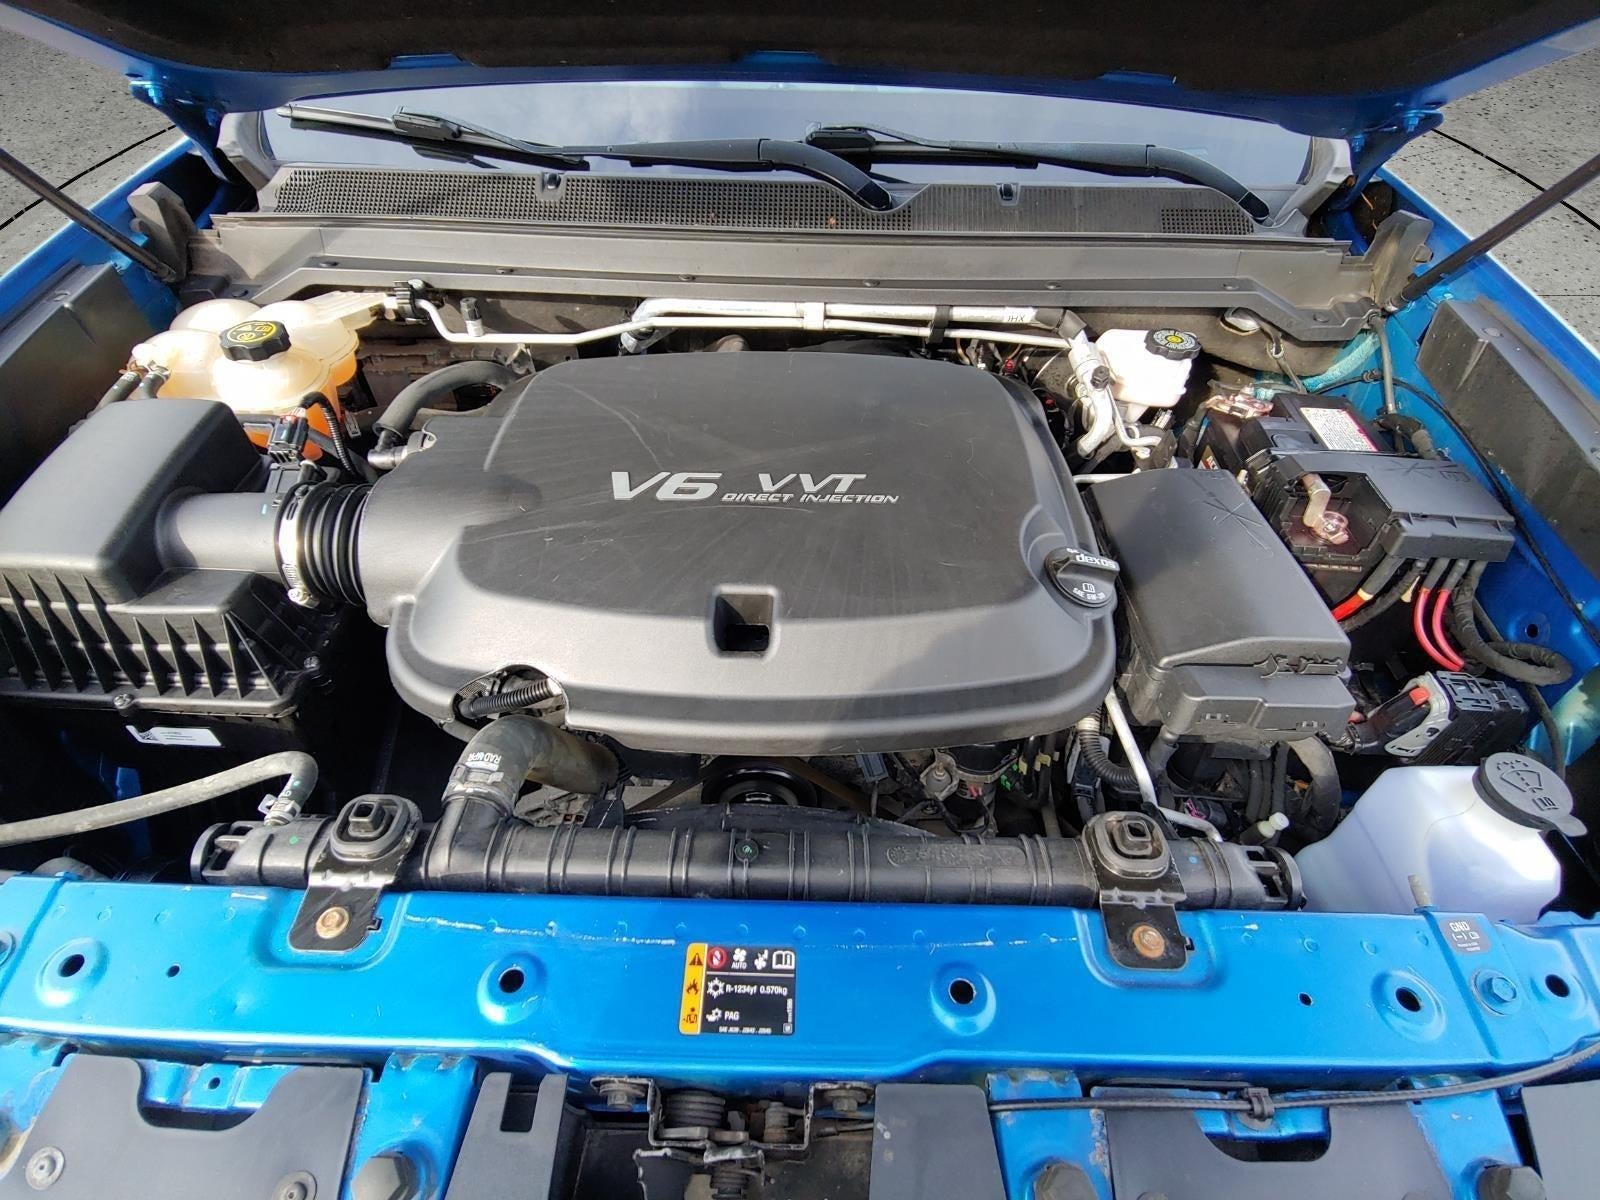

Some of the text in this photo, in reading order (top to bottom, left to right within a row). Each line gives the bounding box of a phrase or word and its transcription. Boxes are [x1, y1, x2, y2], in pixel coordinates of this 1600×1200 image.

[611, 471, 867, 501] V6 VVT
[722, 493, 899, 504] DIRECT INJECTION
[1076, 554, 1115, 568] dexos
[1450, 922, 1469, 932] GND
[731, 961, 747, 970] AUTO
[726, 984, 757, 995] R-1234yf
[724, 1010, 740, 1021] PAG
